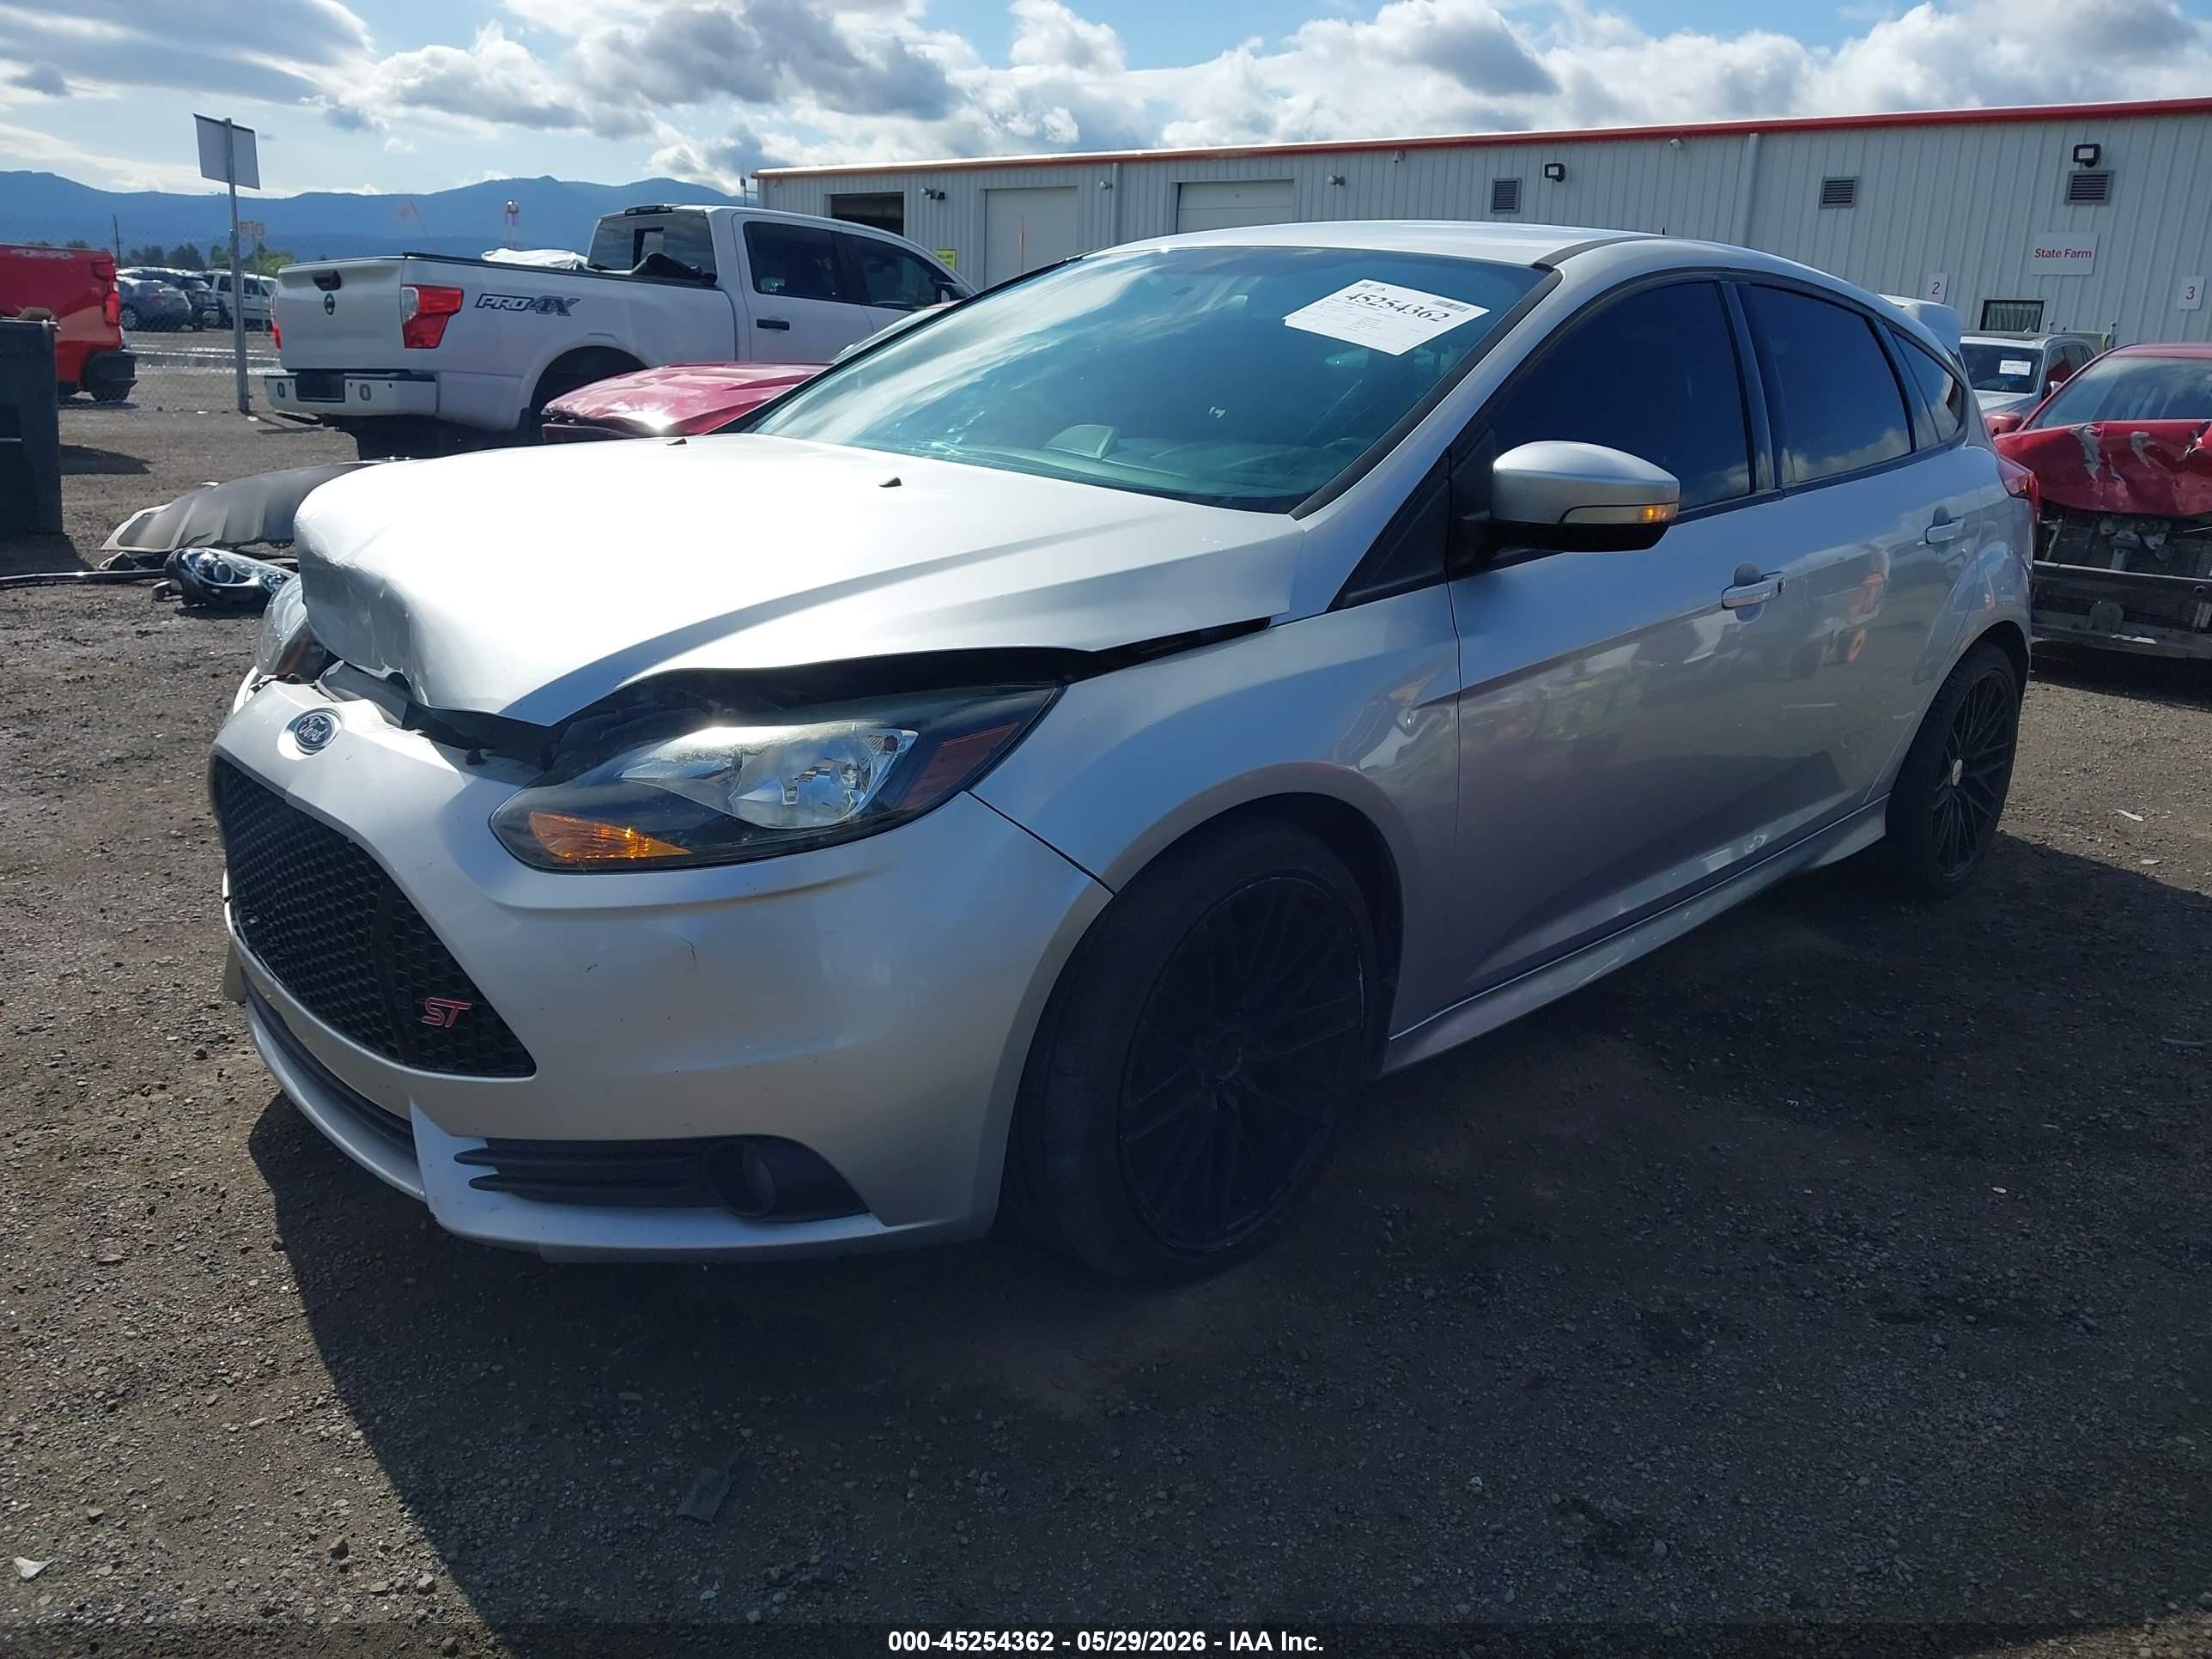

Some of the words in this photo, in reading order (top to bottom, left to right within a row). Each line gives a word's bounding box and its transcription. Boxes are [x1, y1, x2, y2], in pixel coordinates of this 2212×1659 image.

[2034, 247, 2062, 258] State
[2064, 248, 2092, 258] Farm
[1932, 281, 1941, 295] 2
[2185, 285, 2195, 301] 3
[1346, 292, 1451, 323] 45254362
[298, 716, 328, 743] Ford
[421, 996, 472, 1028] ST
